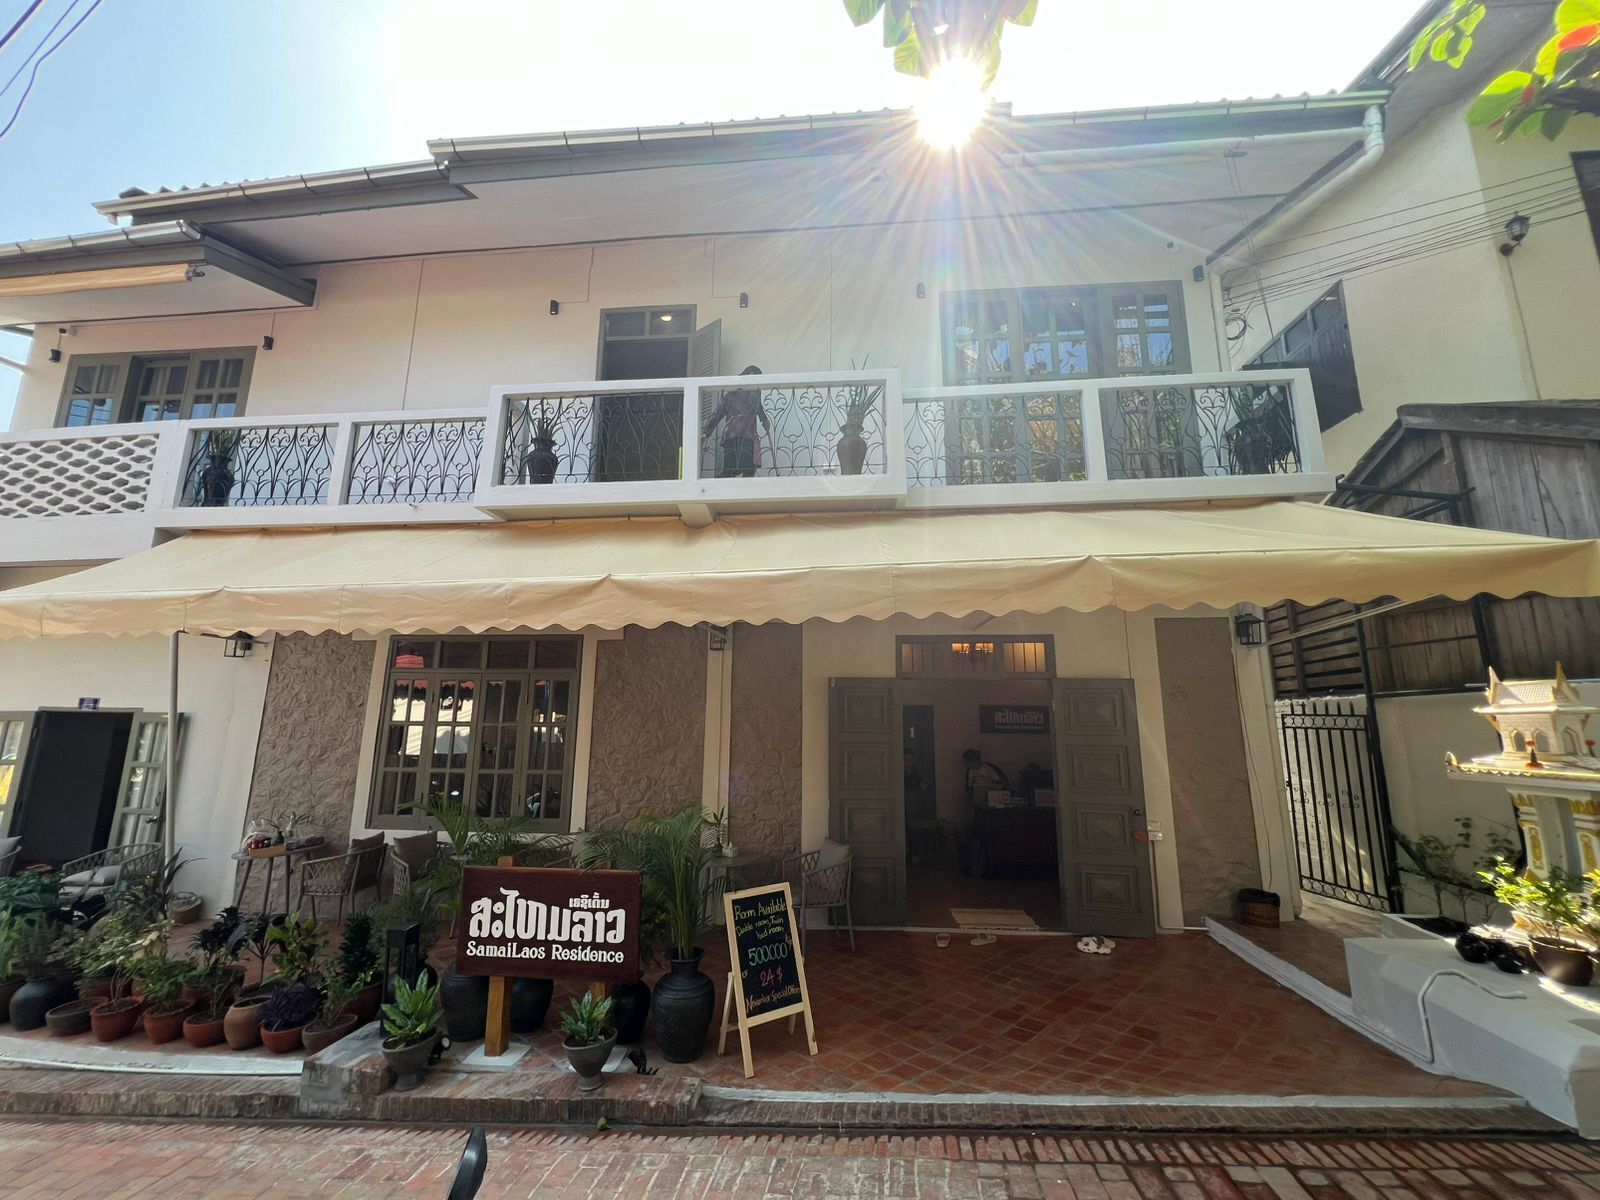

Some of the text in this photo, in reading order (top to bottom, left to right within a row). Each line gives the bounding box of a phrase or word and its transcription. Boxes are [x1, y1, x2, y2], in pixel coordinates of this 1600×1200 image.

[734, 898, 787, 921] Room Available
[735, 923, 754, 937] Double
[466, 940, 624, 964] SamaiLaos Residence
